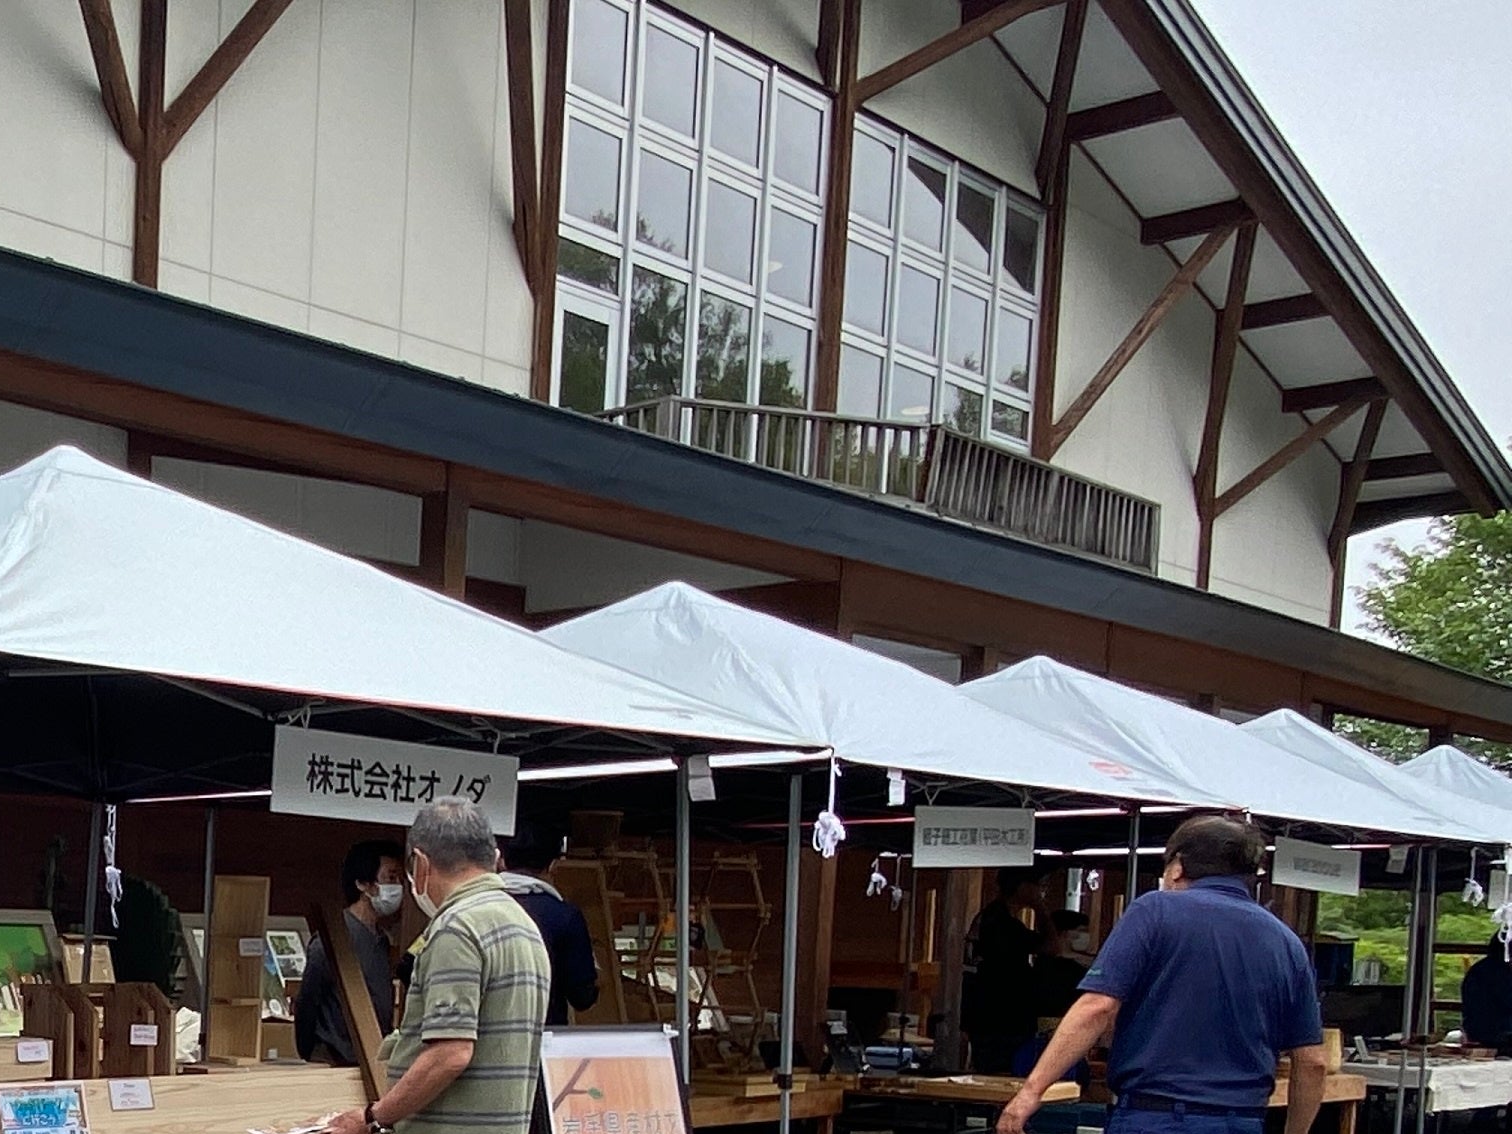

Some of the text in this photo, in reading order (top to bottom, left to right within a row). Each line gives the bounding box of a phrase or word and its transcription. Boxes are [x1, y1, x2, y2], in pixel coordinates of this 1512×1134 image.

[307, 752, 491, 804] 株式会社オノダ
